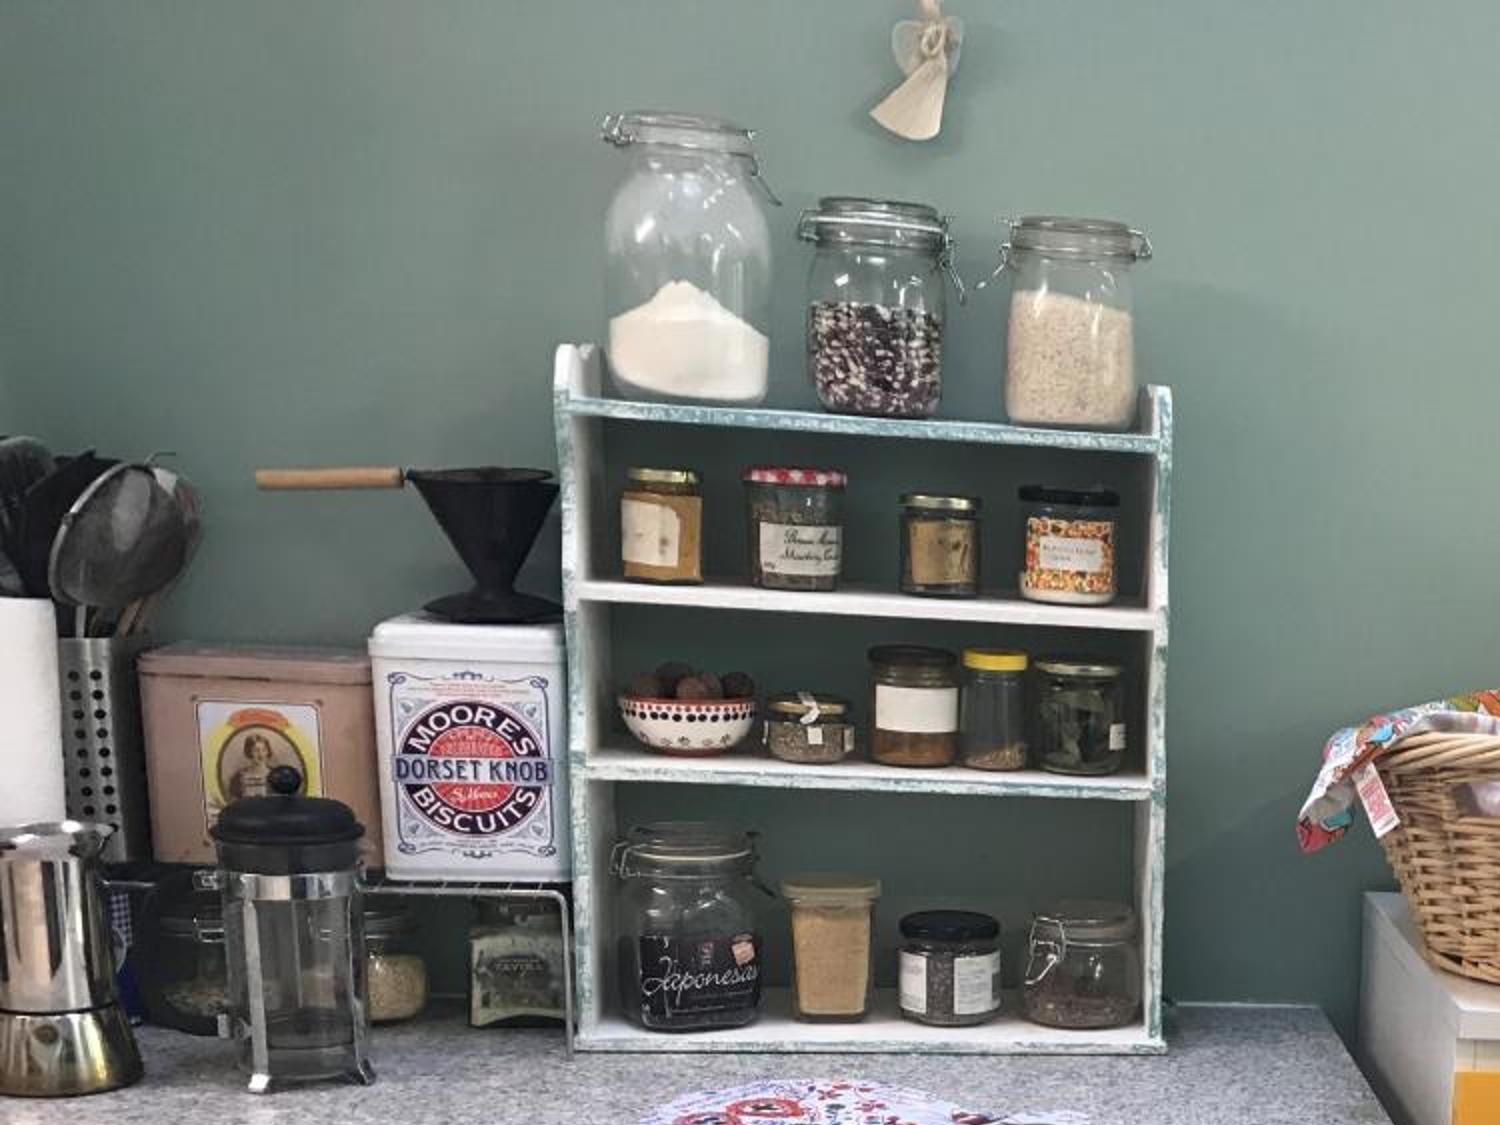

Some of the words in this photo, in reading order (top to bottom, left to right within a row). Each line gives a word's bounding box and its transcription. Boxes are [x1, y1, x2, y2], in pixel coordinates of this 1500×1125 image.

[407, 705, 536, 755] MOORES
[395, 759, 482, 781] DORSET
[489, 761, 548, 781] KNOB
[413, 787, 536, 833] BISCUITS
